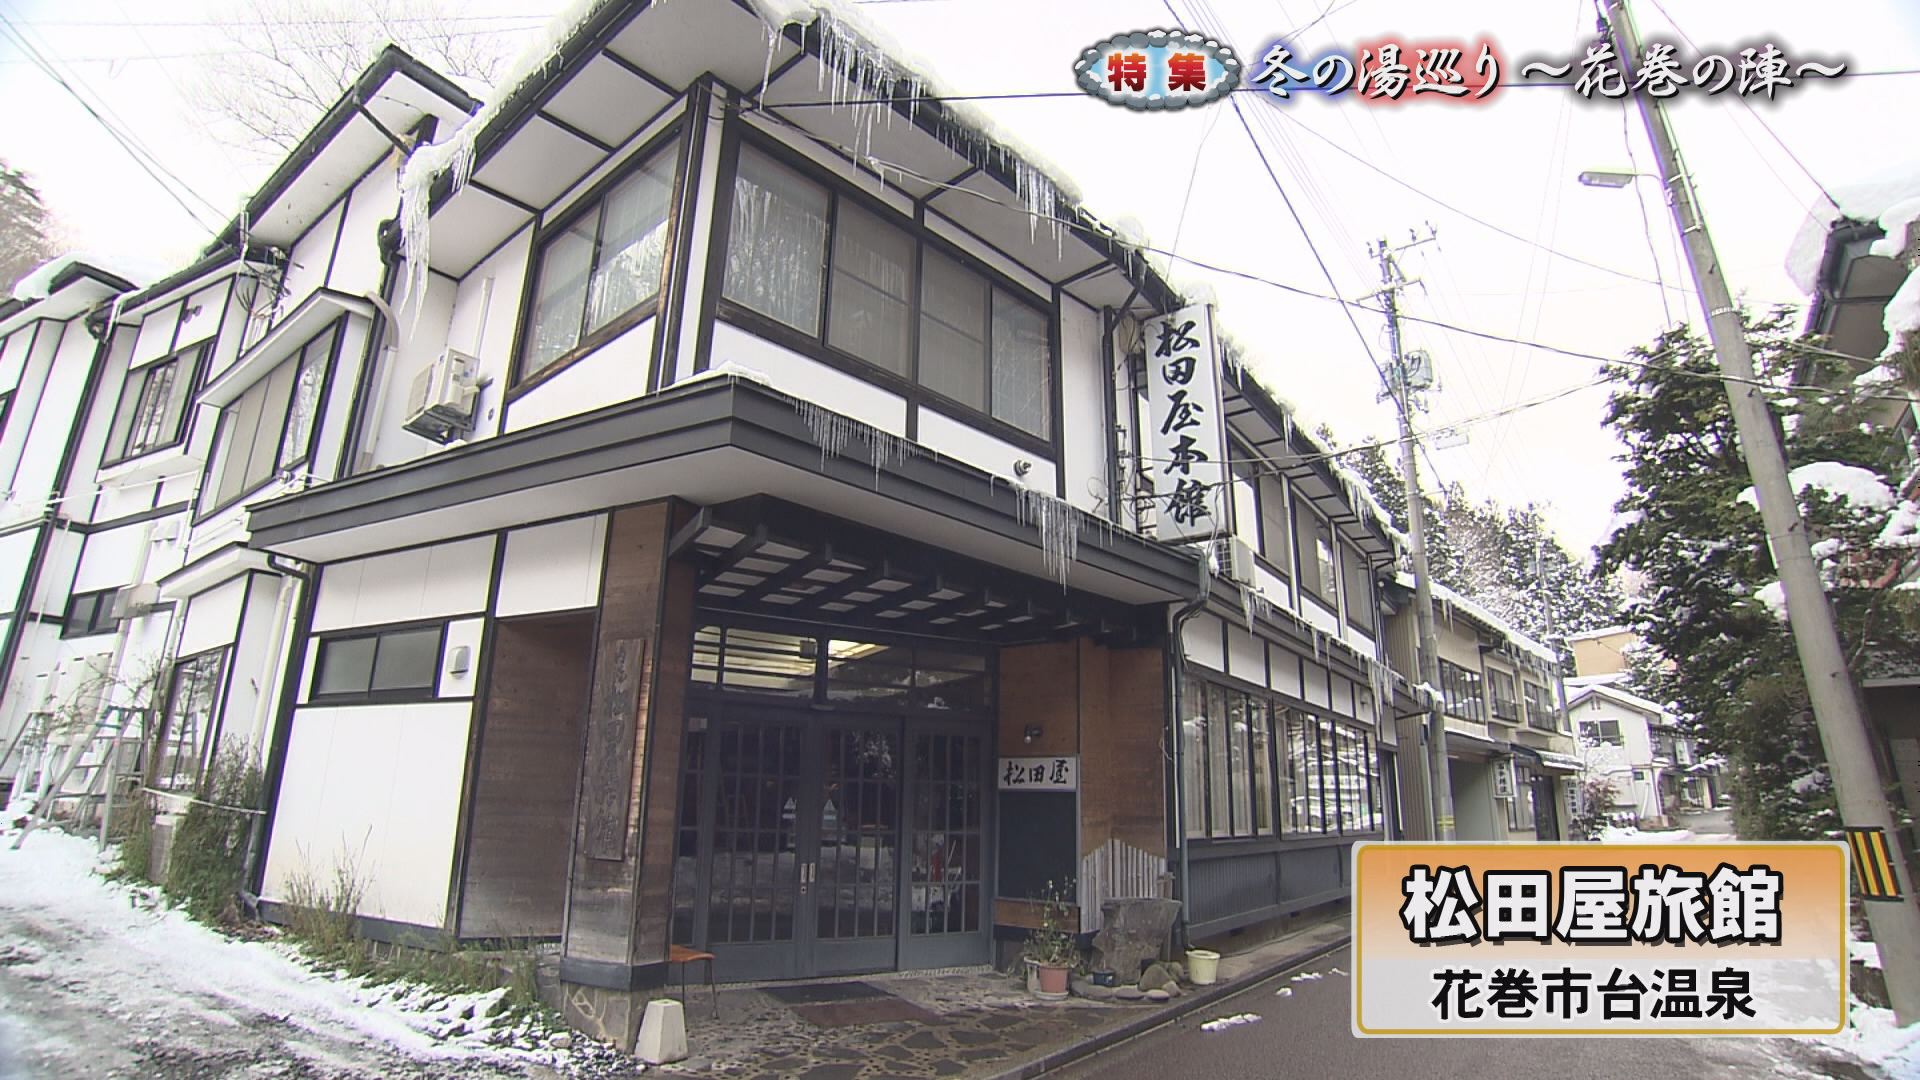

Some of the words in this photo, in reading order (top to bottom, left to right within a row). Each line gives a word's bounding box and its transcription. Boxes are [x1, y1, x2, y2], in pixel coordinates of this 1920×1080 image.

[1155, 320, 1212, 527] 松田屋本館
[1003, 759, 1069, 786] 松田屋
